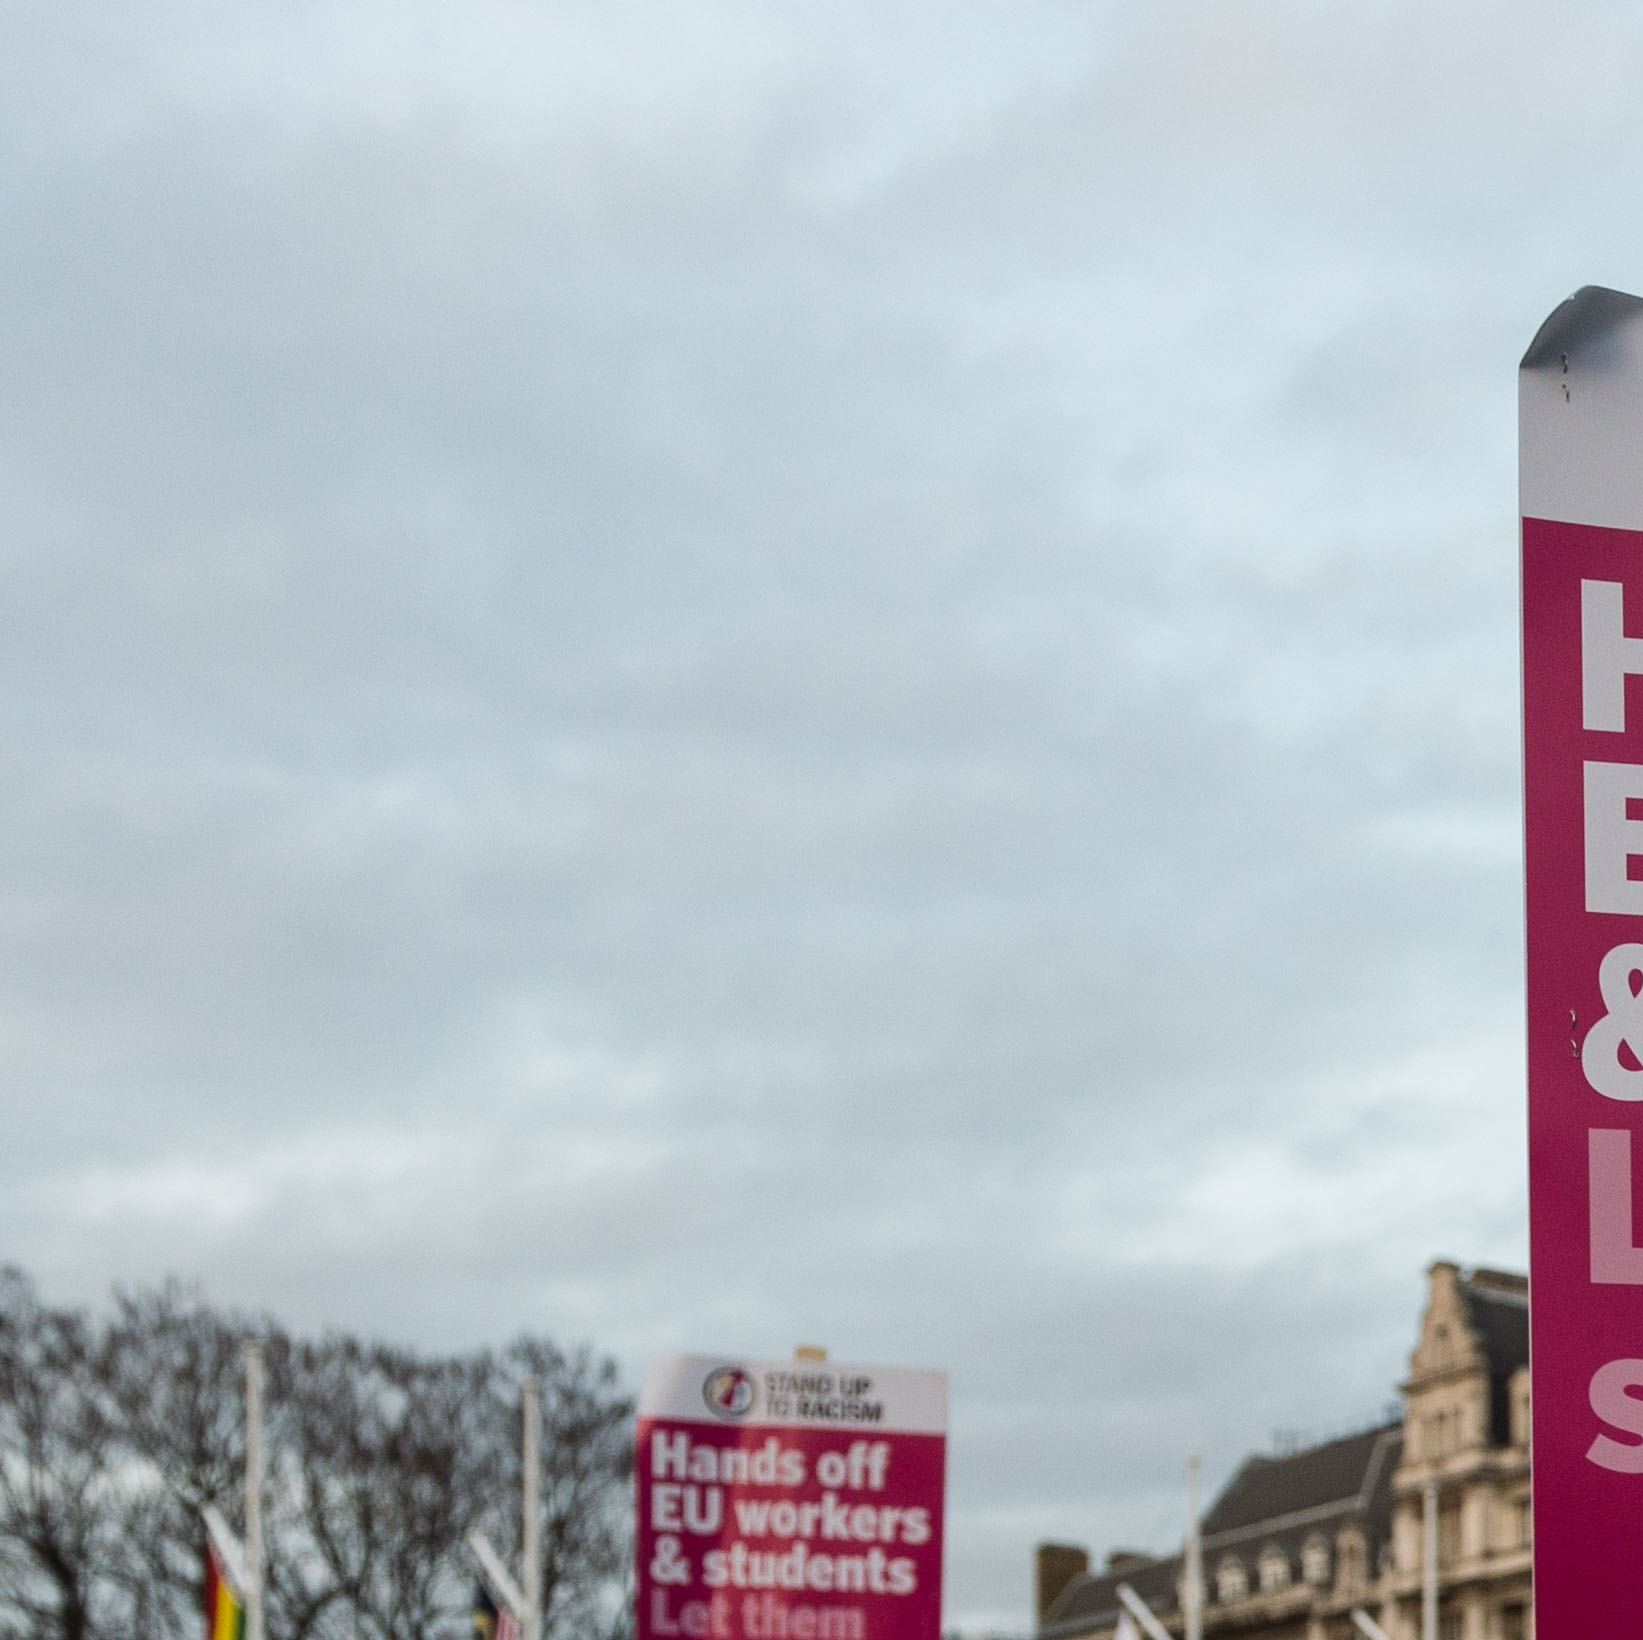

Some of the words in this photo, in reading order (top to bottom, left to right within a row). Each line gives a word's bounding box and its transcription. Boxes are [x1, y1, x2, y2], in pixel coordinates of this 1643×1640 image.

[653, 1432, 805, 1485] Hands
[817, 1443, 888, 1488] off
[653, 1485, 721, 1532] EU
[735, 1492, 929, 1542] workers
[652, 1537, 687, 1582] &
[705, 1541, 915, 1593] students
[653, 1590, 731, 1639] Let
